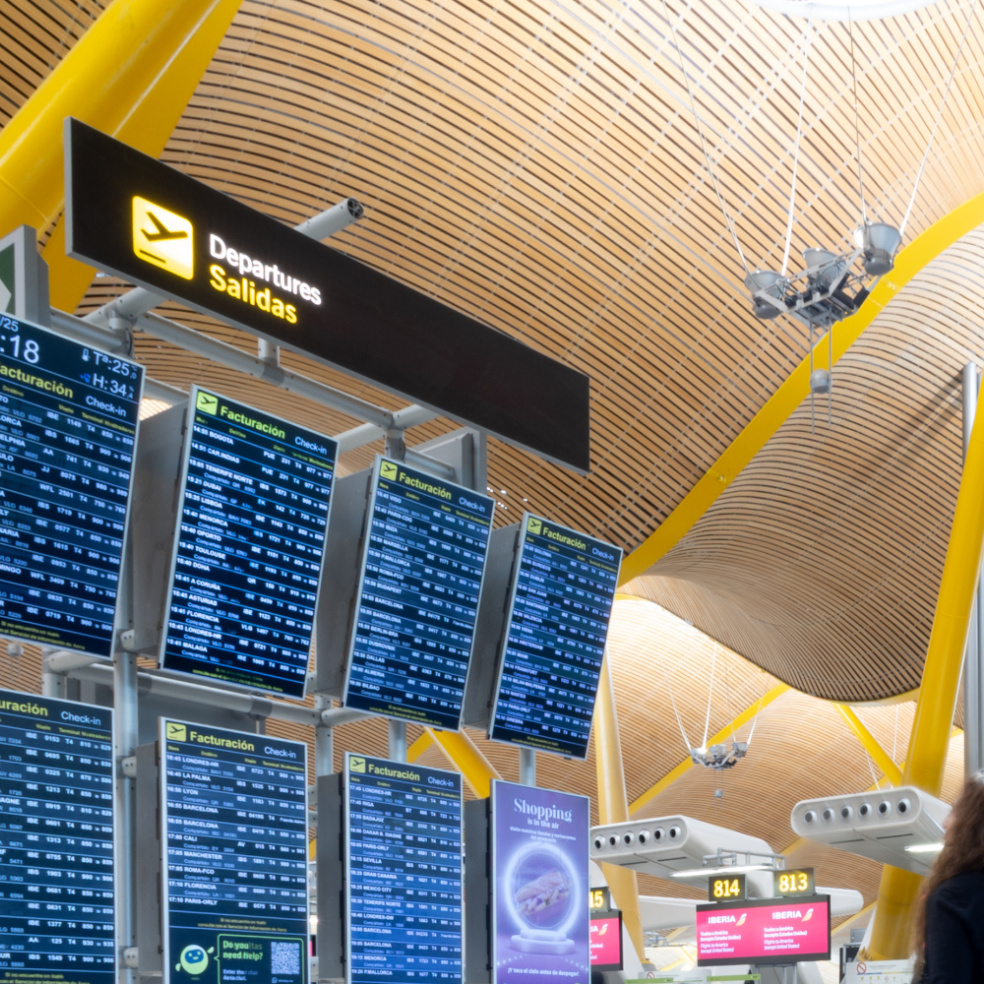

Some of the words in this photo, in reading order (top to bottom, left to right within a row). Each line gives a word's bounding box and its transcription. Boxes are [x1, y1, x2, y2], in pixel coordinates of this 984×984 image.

[209, 233, 322, 305] Departures
[209, 264, 297, 324] Salidas
[85, 394, 127, 417] Check-in
[220, 405, 285, 440] Facturación
[294, 436, 328, 456] Check-in
[398, 471, 452, 501] Facturación
[458, 495, 486, 513] Check-in
[542, 526, 587, 551] Facturación
[591, 546, 615, 561] Check-in
[60, 709, 102, 727] Check-in
[189, 730, 255, 752] Facturación
[264, 745, 297, 760] Check-in
[368, 763, 420, 782] Facturación
[427, 775, 455, 788] Check-in
[513, 798, 573, 823] Shopping
[713, 880, 741, 898] 814
[778, 872, 809, 893] 813
[708, 914, 736, 924] IBERIA
[772, 910, 802, 920] IBERIA
